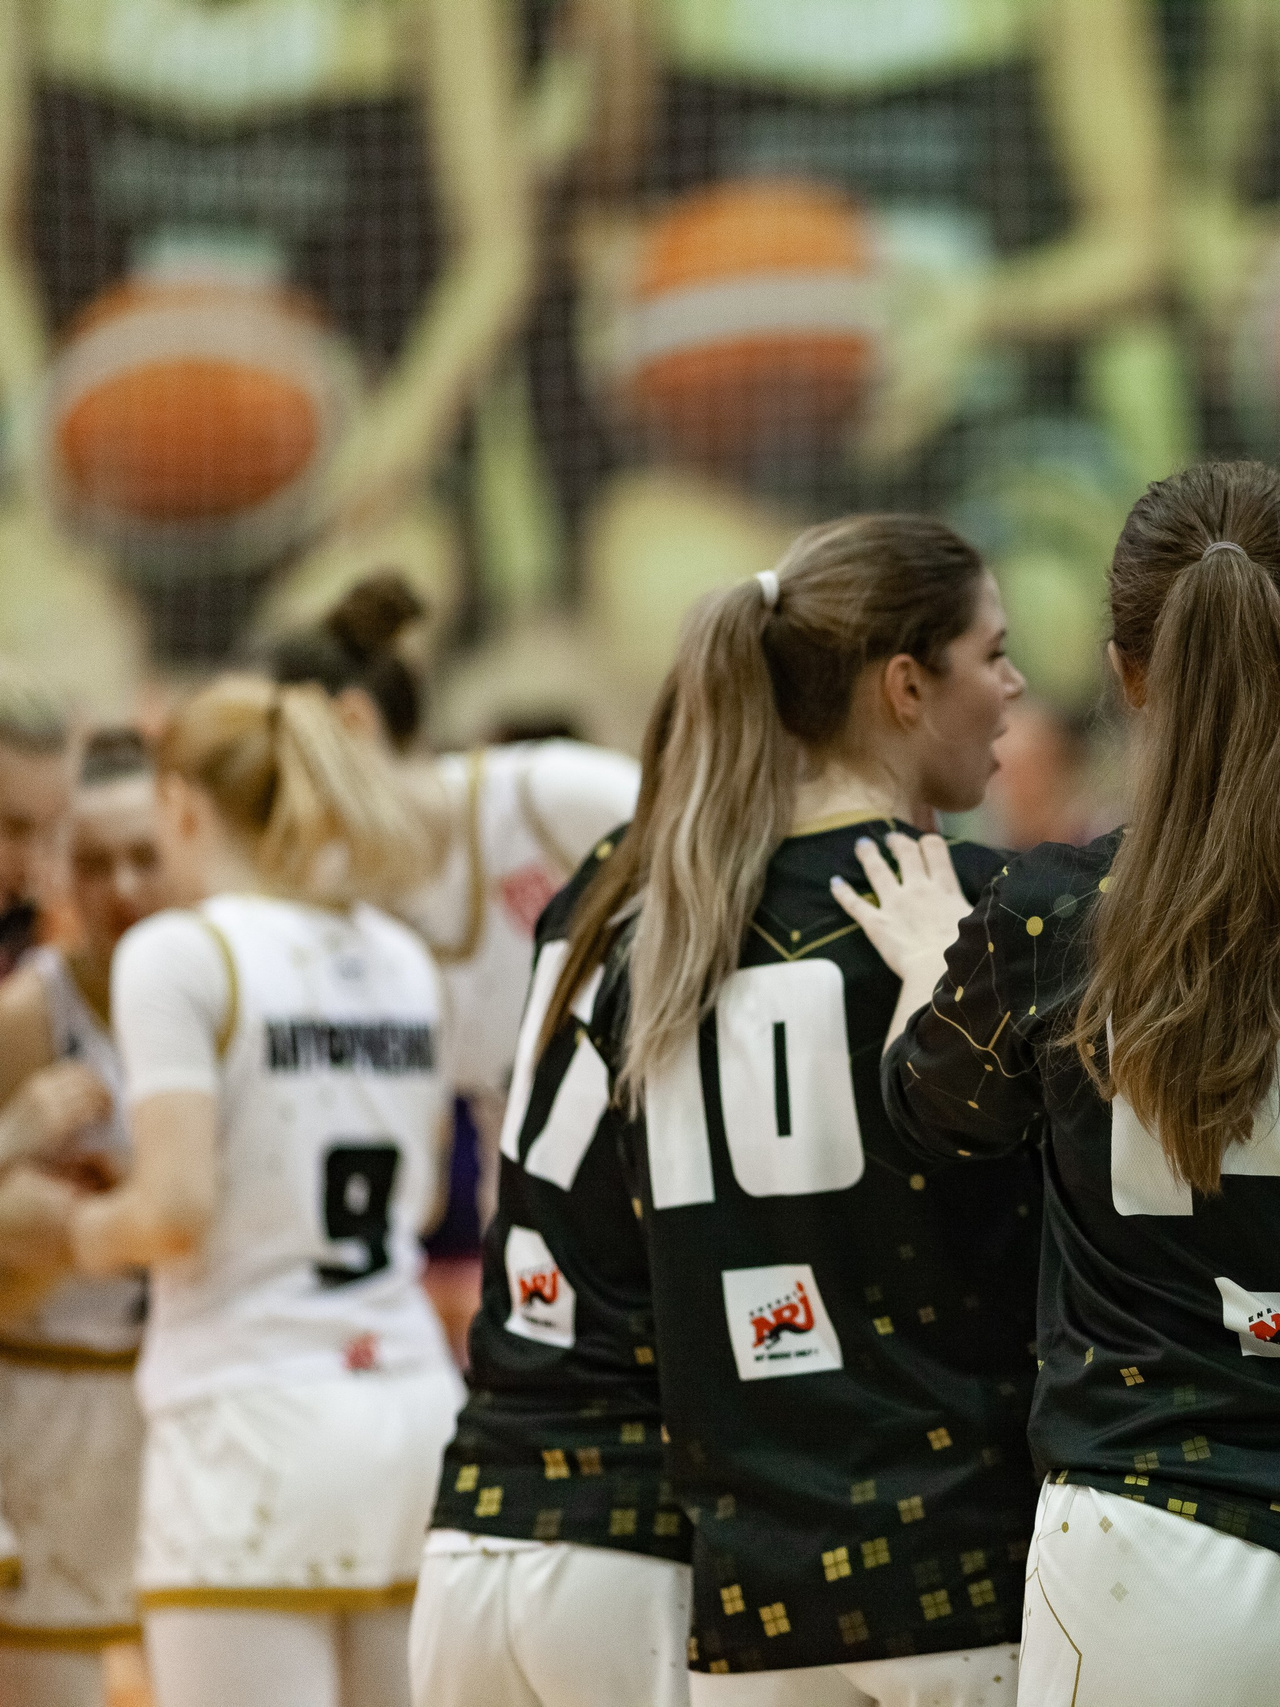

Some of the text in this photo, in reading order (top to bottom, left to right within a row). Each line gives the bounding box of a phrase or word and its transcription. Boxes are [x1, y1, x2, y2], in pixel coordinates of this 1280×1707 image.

[645, 957, 866, 1211] 10
[314, 1141, 404, 1291] 9
[750, 1280, 816, 1350] NRJ
